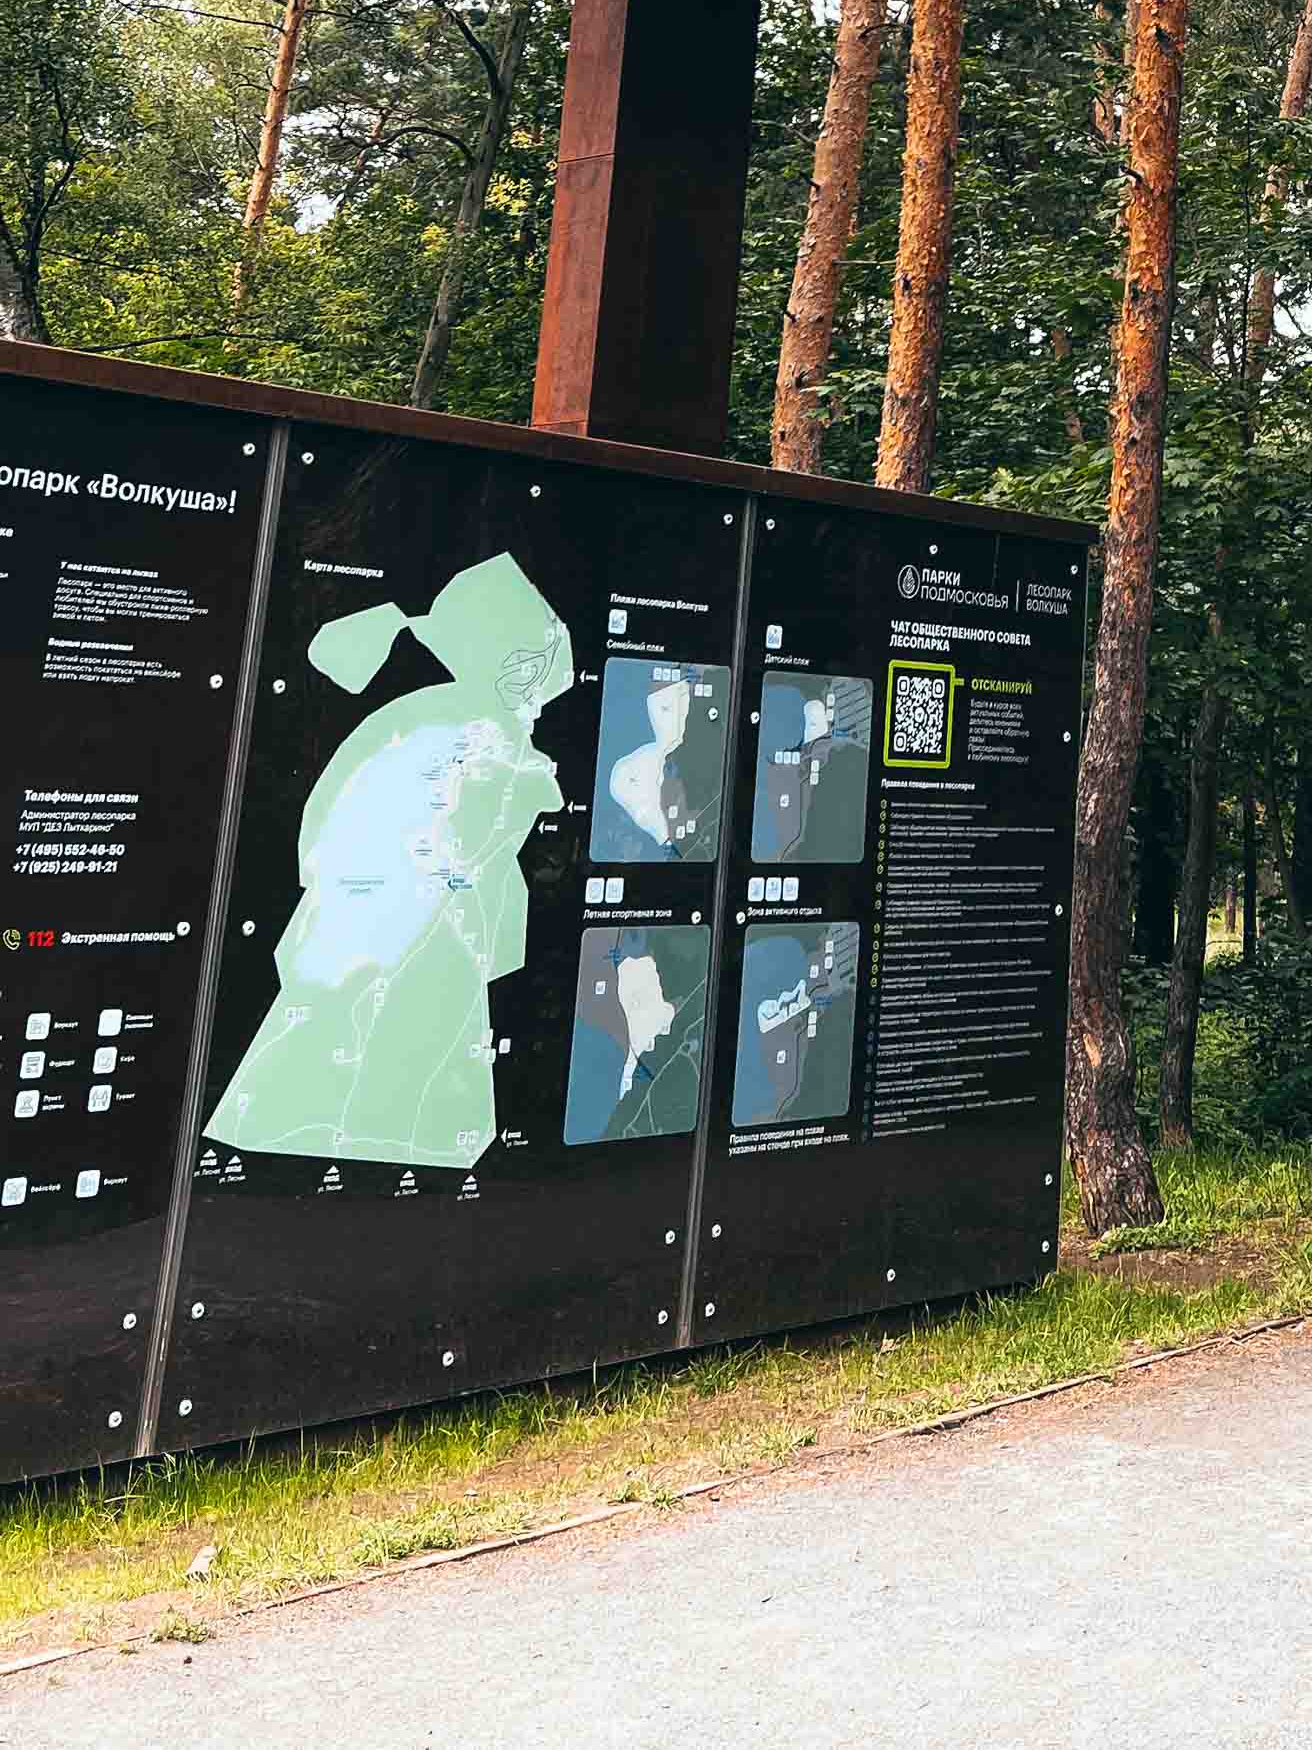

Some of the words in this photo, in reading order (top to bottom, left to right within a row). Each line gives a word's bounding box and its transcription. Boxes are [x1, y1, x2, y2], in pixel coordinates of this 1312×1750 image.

[86, 472, 237, 514] «Волкуша»!
[922, 568, 961, 586] ПАРКИ
[921, 585, 1009, 610] ПОДМОСКОВЬЯ
[1026, 583, 1073, 601] ЛЕСОПАРК
[1025, 599, 1068, 616] ВОЛКУША
[890, 620, 911, 635] ЧАТ
[911, 622, 996, 643] ОБЩЕСТВЕННОГО
[996, 631, 1032, 646] СОВЕТА
[889, 634, 950, 652] ЛЕСОПАРКА
[971, 677, 1032, 696] ОТСКАНИРУЙ
[24, 789, 84, 804] Телефоны
[83, 794, 106, 804] для
[106, 794, 139, 804] связи
[27, 930, 55, 947] 112
[61, 931, 130, 946] Экстренная
[130, 932, 176, 943] помощь
